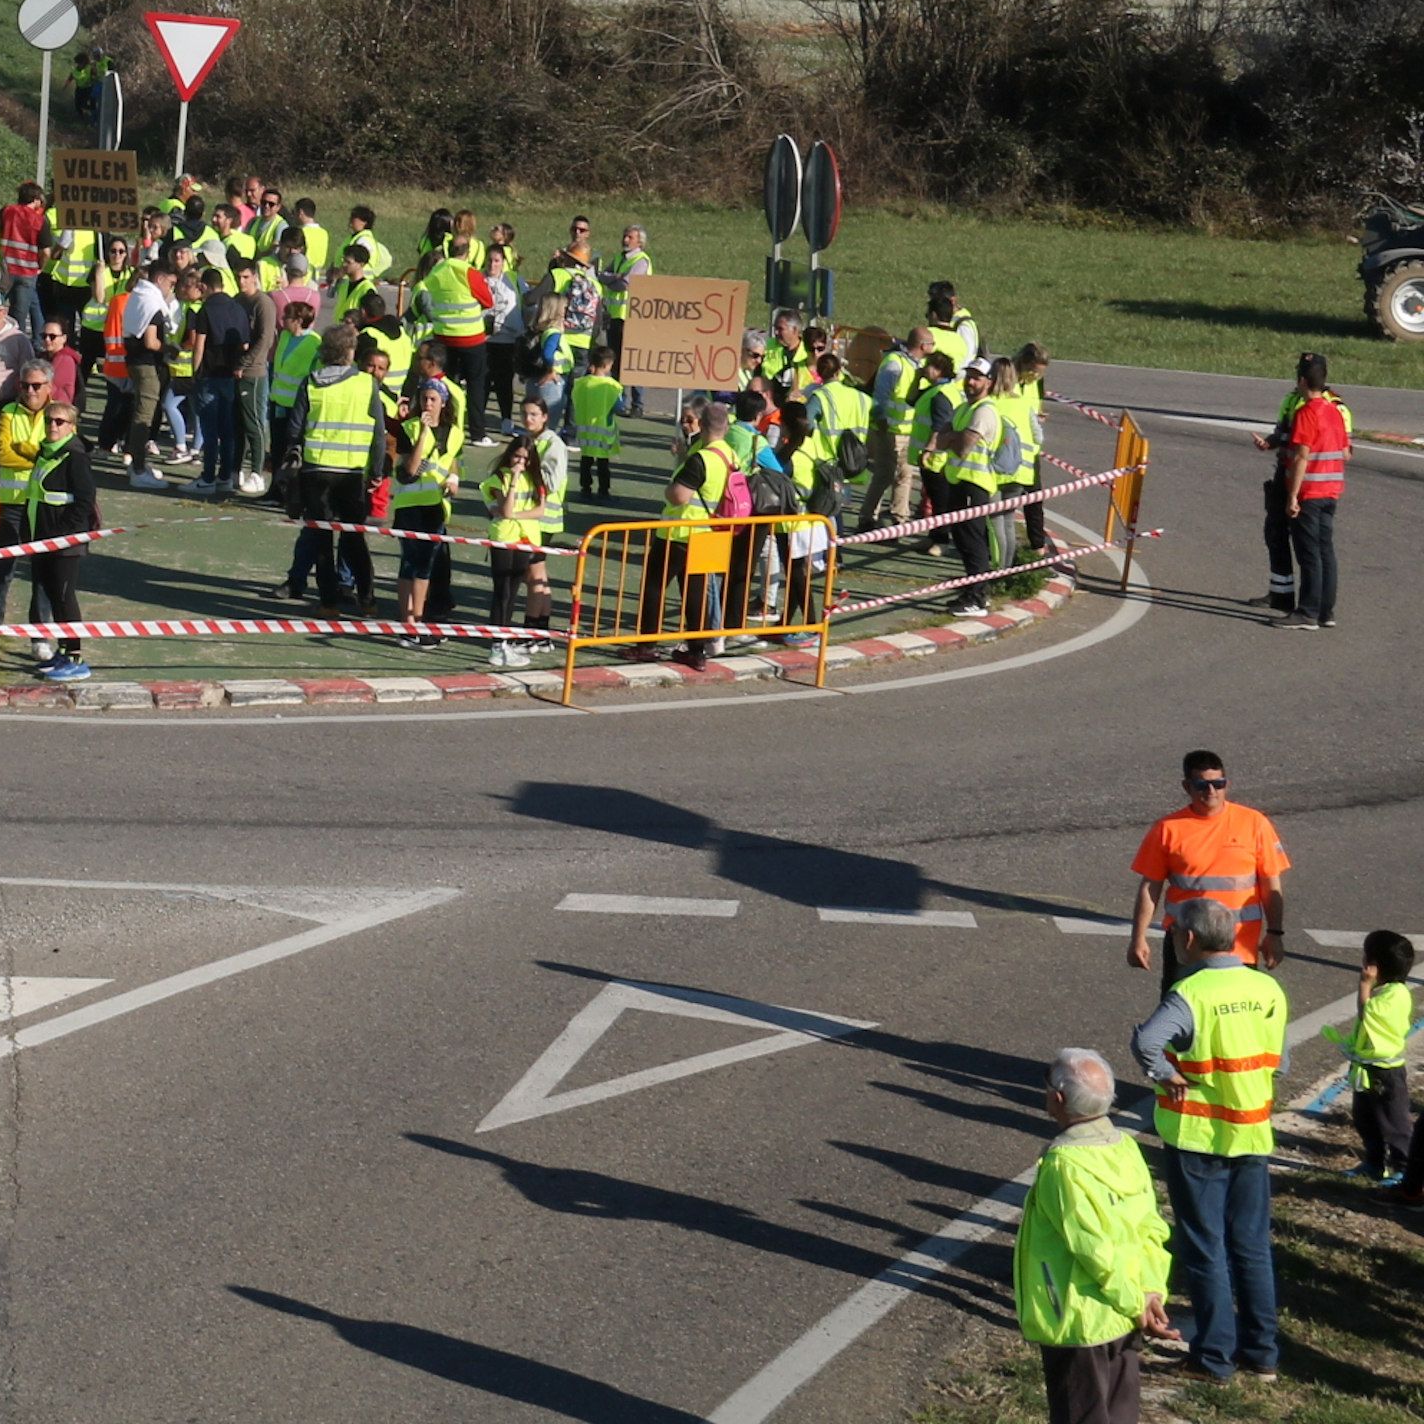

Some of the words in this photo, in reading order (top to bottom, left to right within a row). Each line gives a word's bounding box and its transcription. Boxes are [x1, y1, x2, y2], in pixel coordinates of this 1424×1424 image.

[63, 158, 128, 181] VOLEM
[60, 184, 137, 205] ROTONDES
[66, 208, 76, 226] A
[81, 209, 101, 227] LA
[628, 296, 702, 321] ROTONDES
[696, 287, 739, 336] SÍ
[623, 347, 694, 375] ILLETES
[692, 344, 738, 382] NO
[1213, 1000, 1263, 1016] IBERIA
